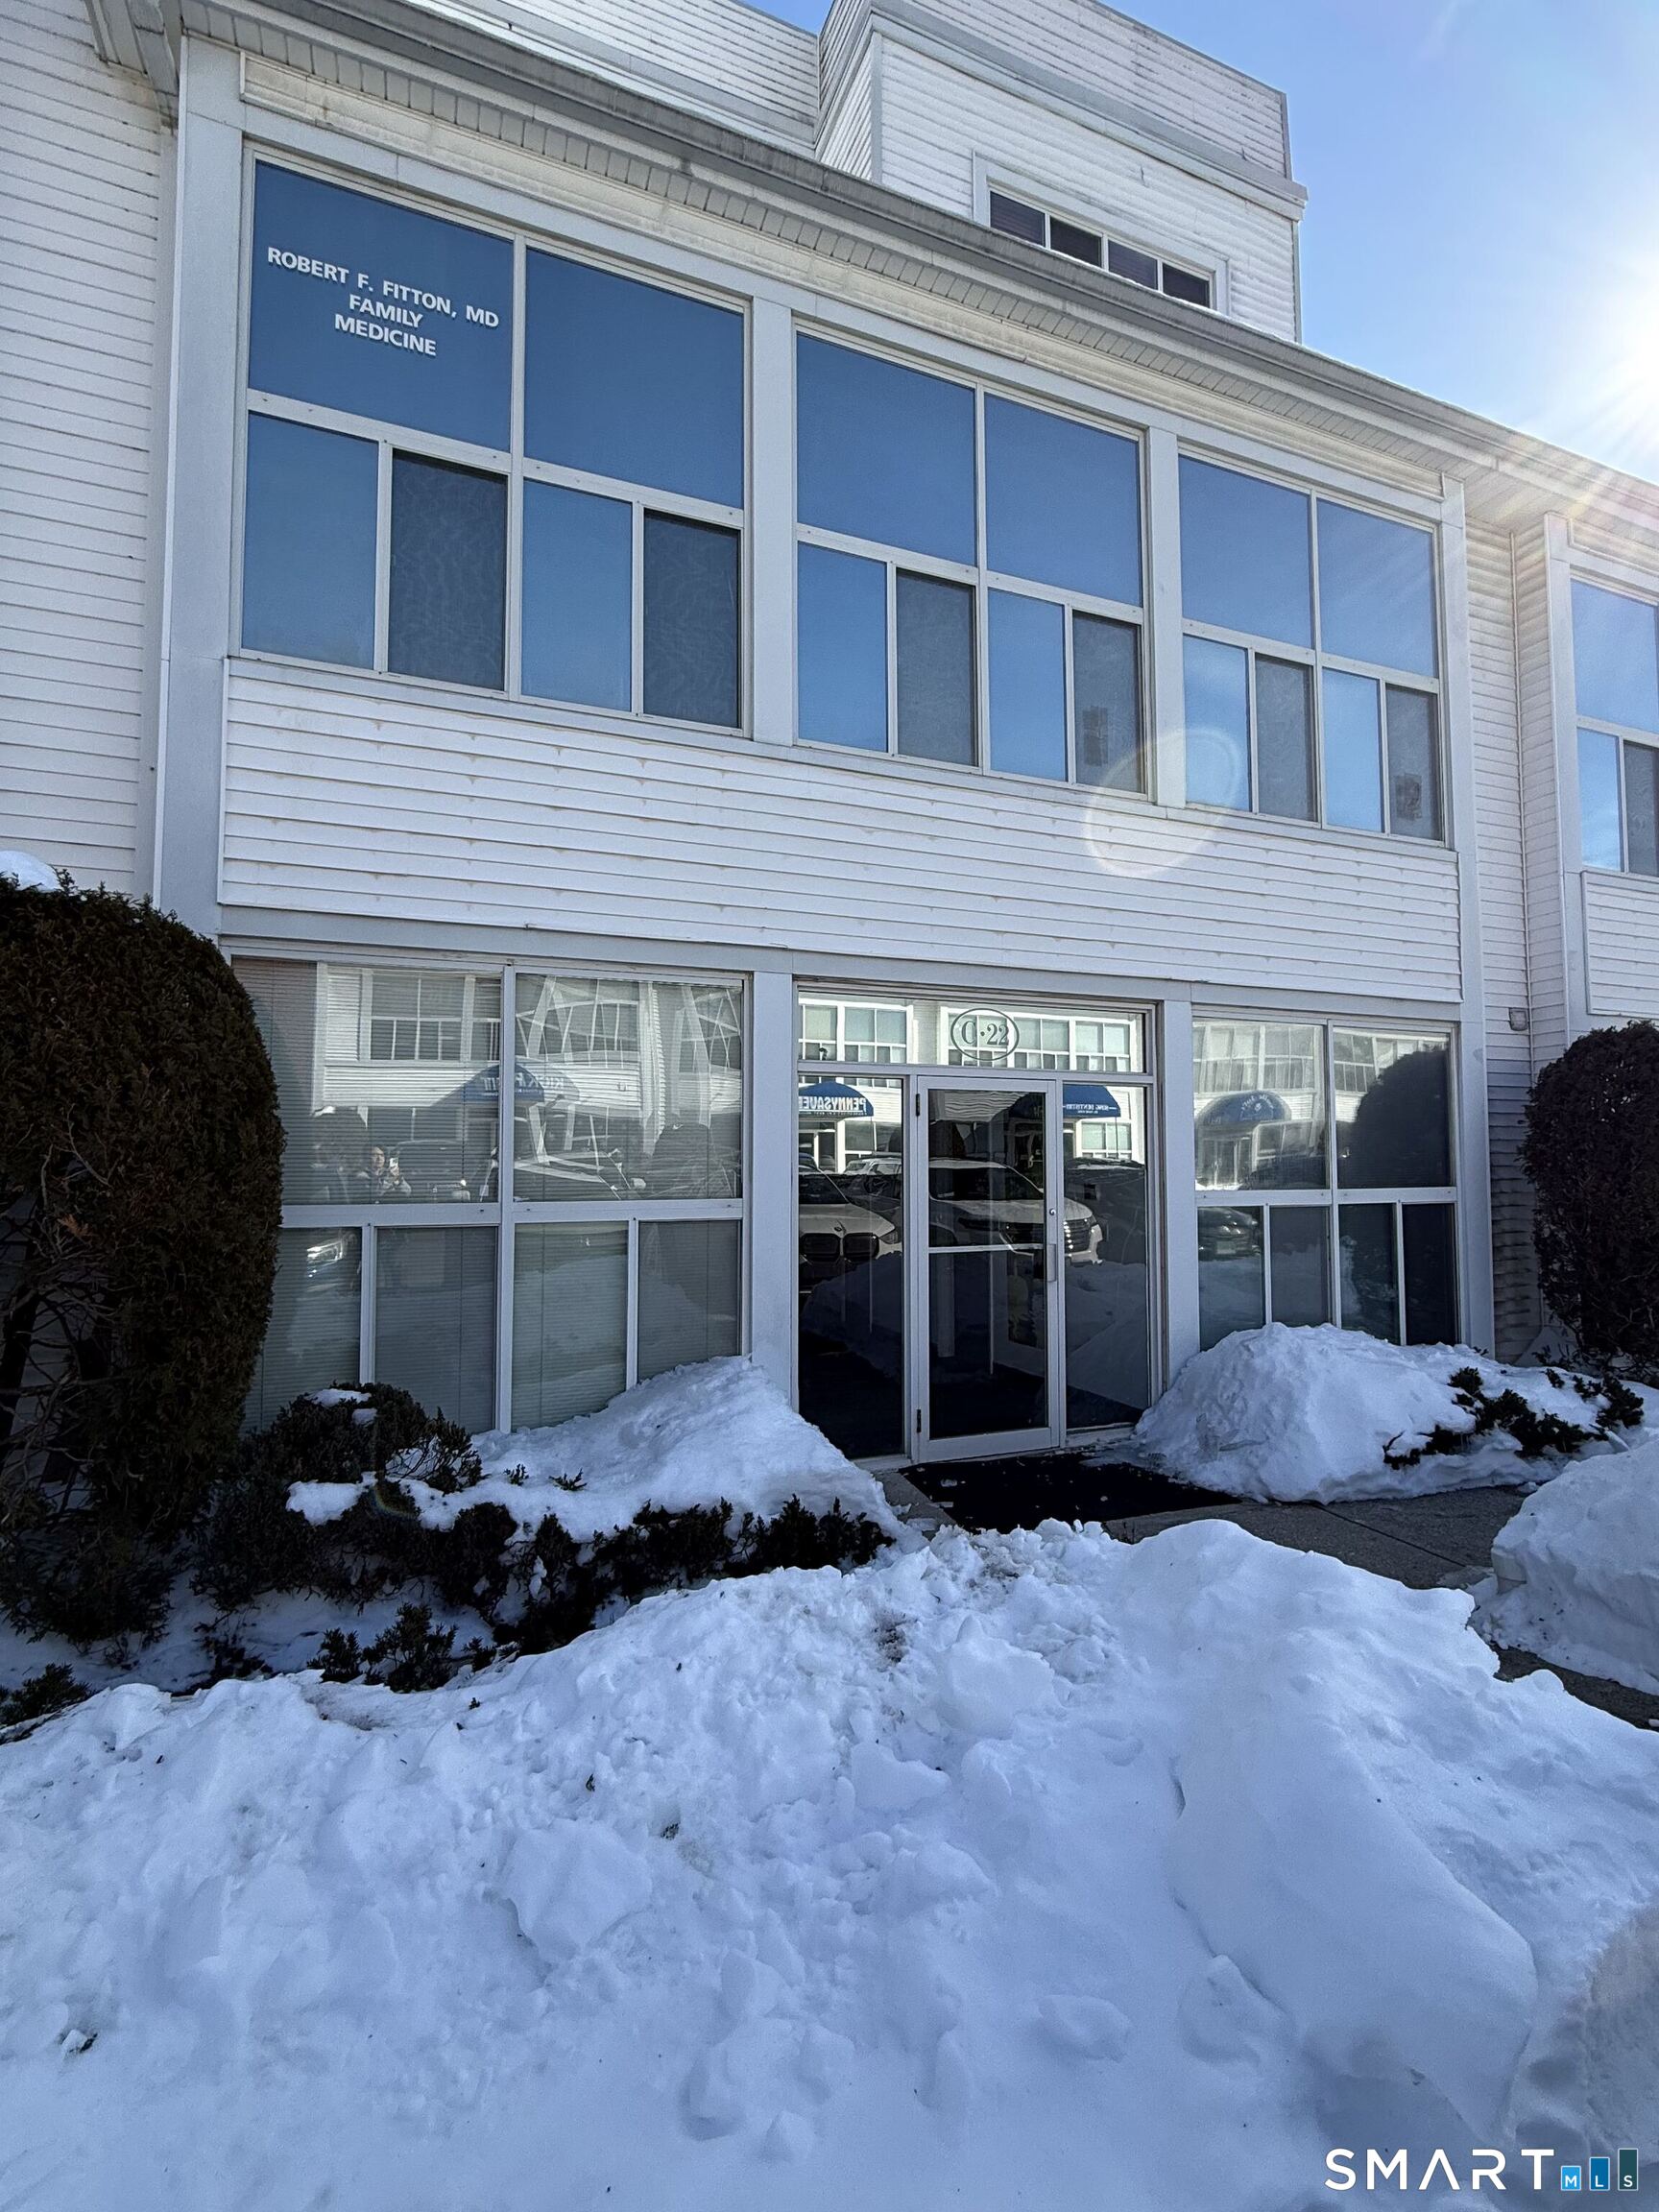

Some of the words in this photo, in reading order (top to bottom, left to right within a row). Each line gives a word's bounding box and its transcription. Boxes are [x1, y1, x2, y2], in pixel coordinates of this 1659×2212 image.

[267, 247, 349, 284] ROBERT
[357, 273, 374, 293] F.
[382, 280, 457, 318] FITTON,
[466, 304, 499, 328] MD
[349, 294, 423, 328] FAMILY
[334, 314, 437, 356] MEDICINE
